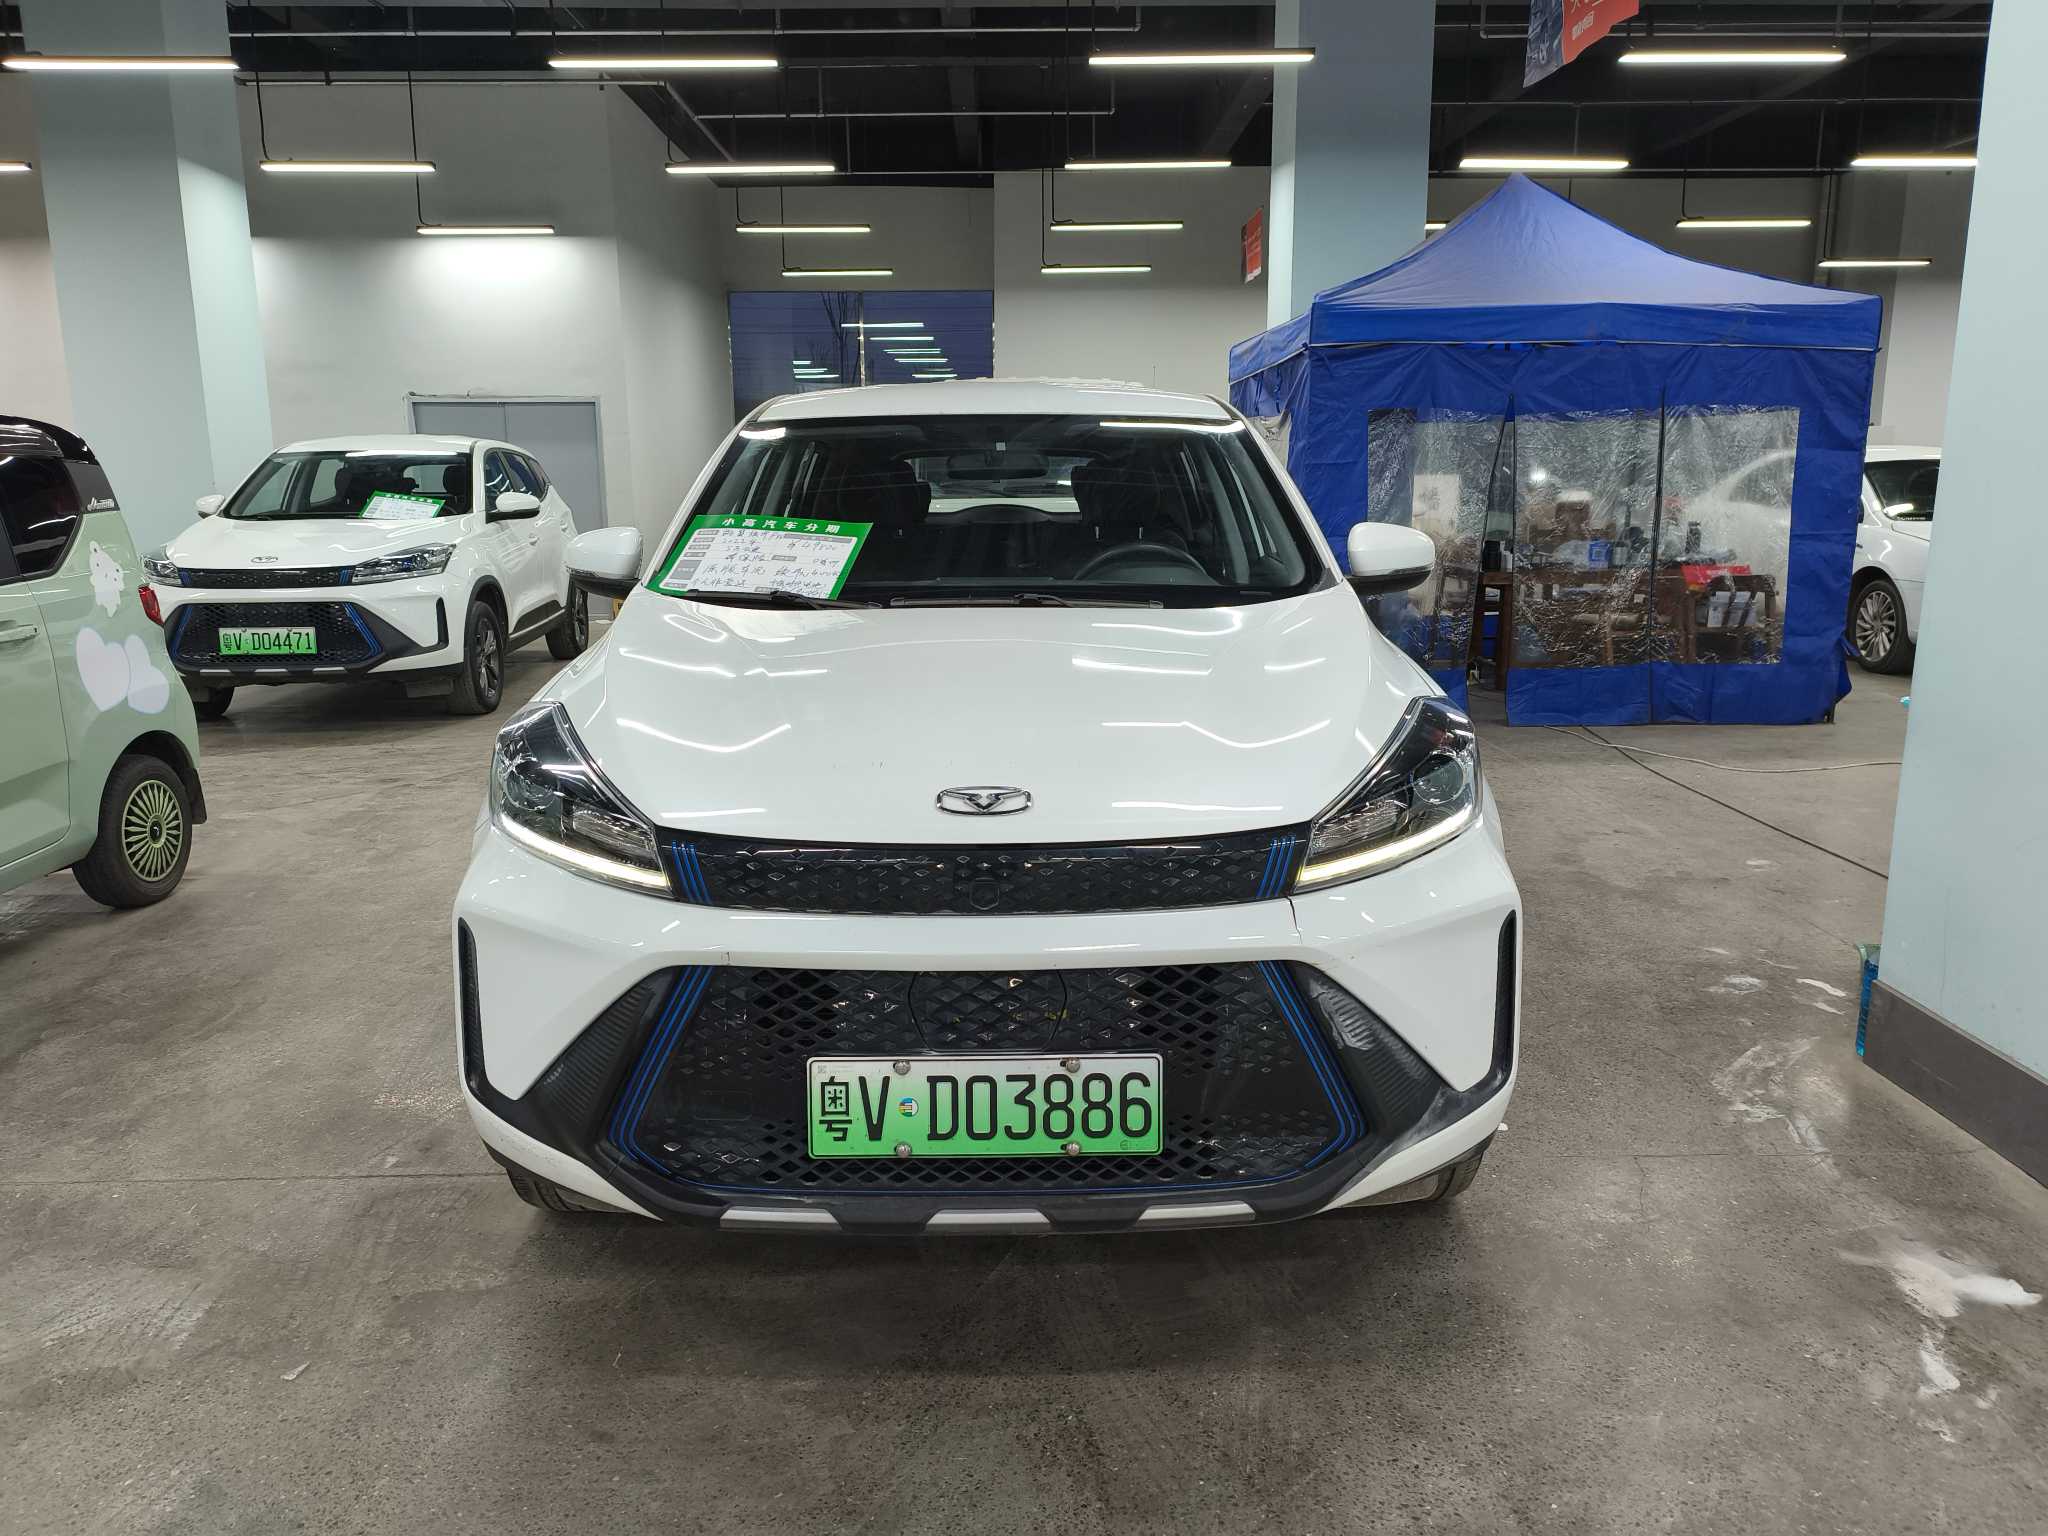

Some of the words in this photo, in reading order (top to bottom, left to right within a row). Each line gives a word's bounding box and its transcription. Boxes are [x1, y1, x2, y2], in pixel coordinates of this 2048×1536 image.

[721, 518, 842, 535] 小高汽车分期
[251, 631, 313, 651] D04471
[818, 1076, 891, 1142] 粤V
[926, 1072, 1153, 1141] D03886
